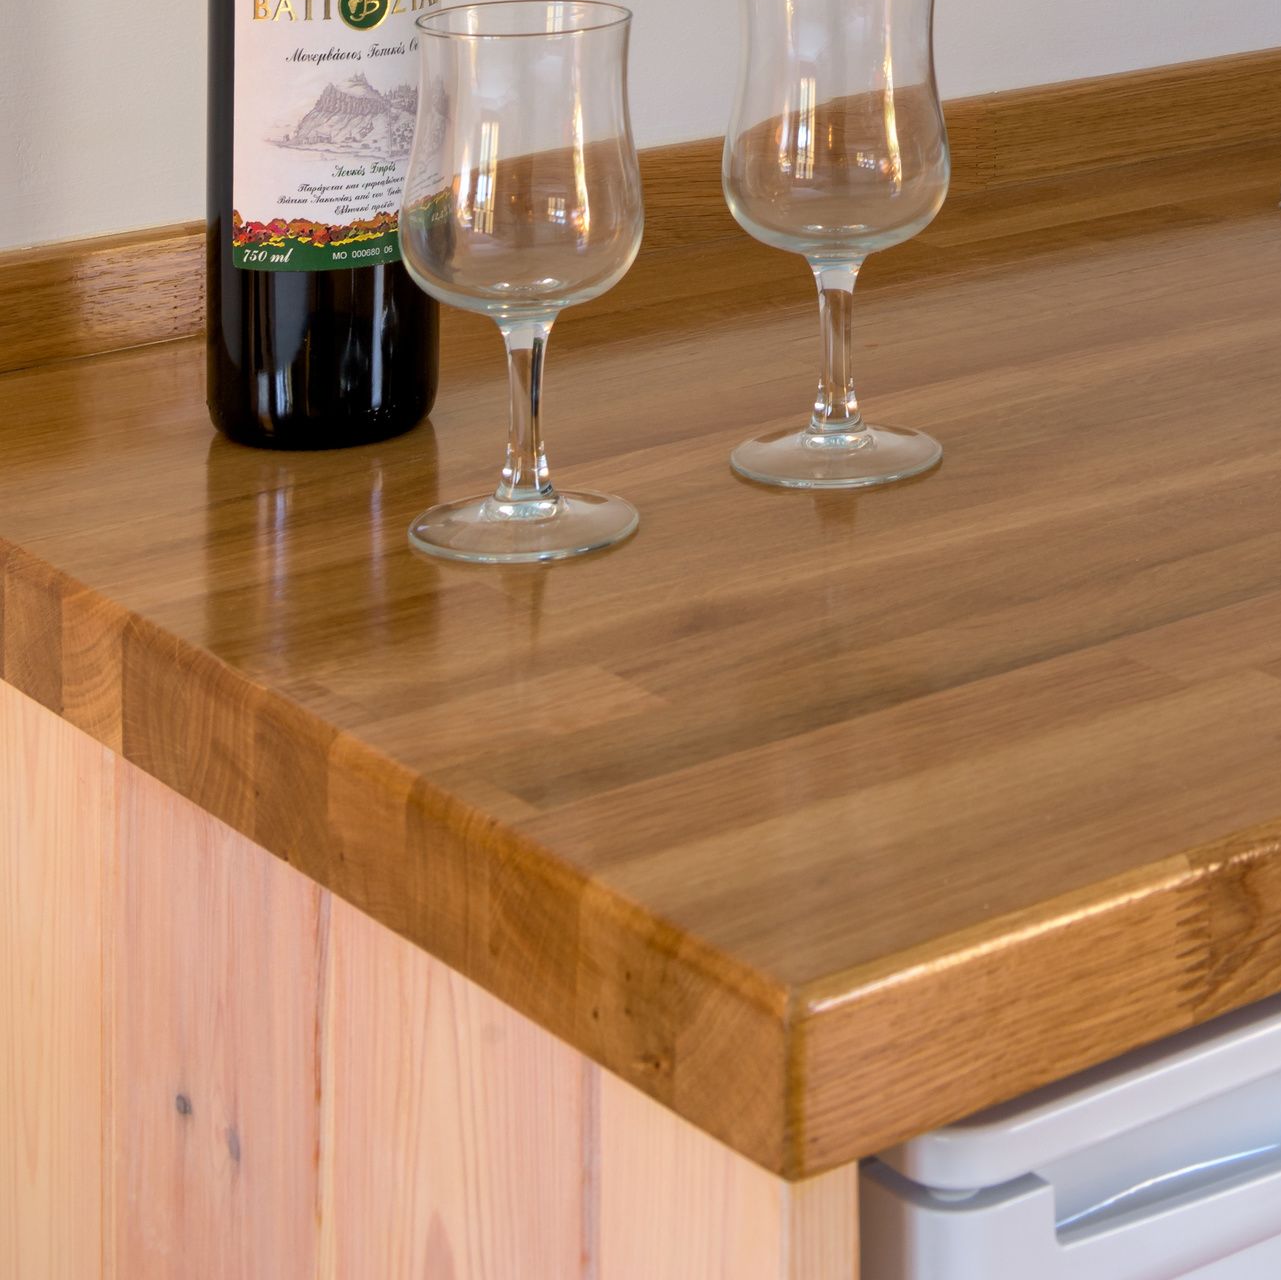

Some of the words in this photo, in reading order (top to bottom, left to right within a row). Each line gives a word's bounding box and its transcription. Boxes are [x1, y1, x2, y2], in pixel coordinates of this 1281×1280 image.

[367, 42, 406, 58] Τοπικός
[243, 248, 268, 263] 750
[270, 247, 294, 263] ml
